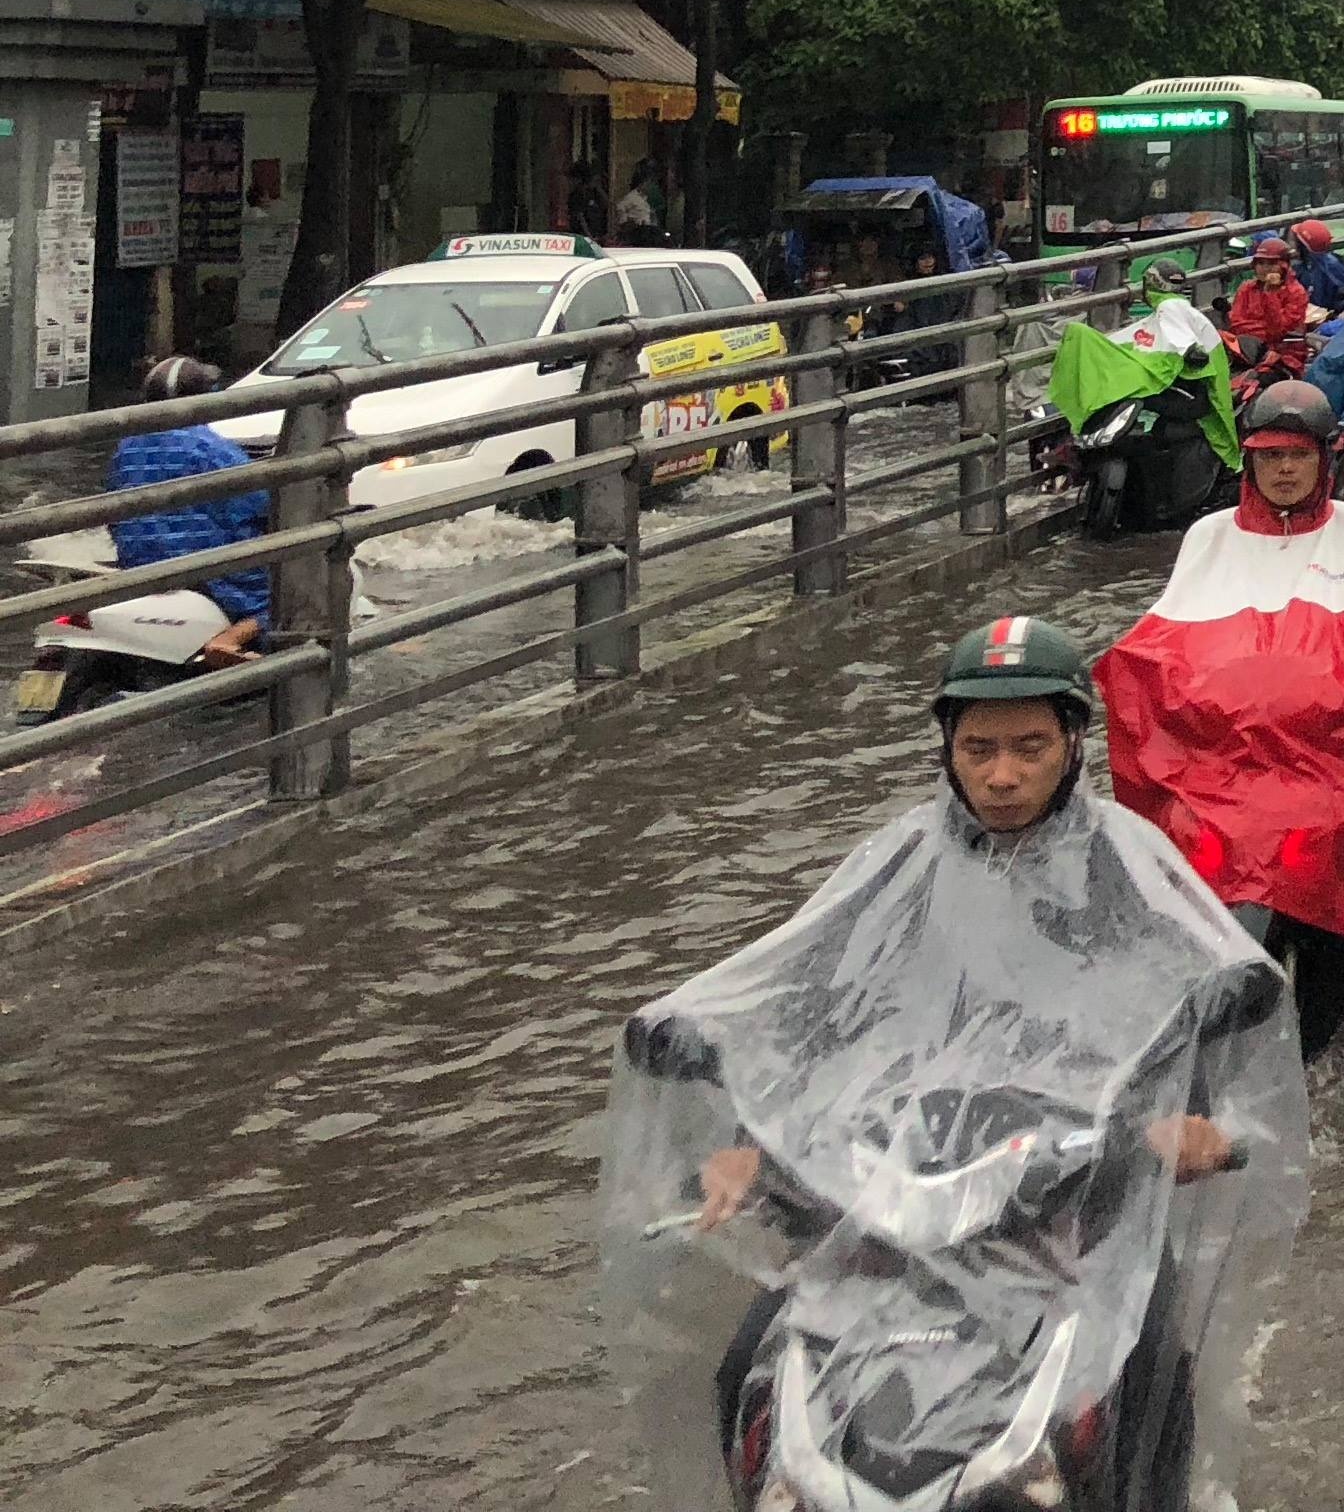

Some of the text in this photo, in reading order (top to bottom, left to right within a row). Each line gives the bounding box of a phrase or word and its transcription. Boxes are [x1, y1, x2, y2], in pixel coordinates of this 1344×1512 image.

[1062, 113, 1095, 134] 16
[478, 238, 572, 251] VINASUN TAXI
